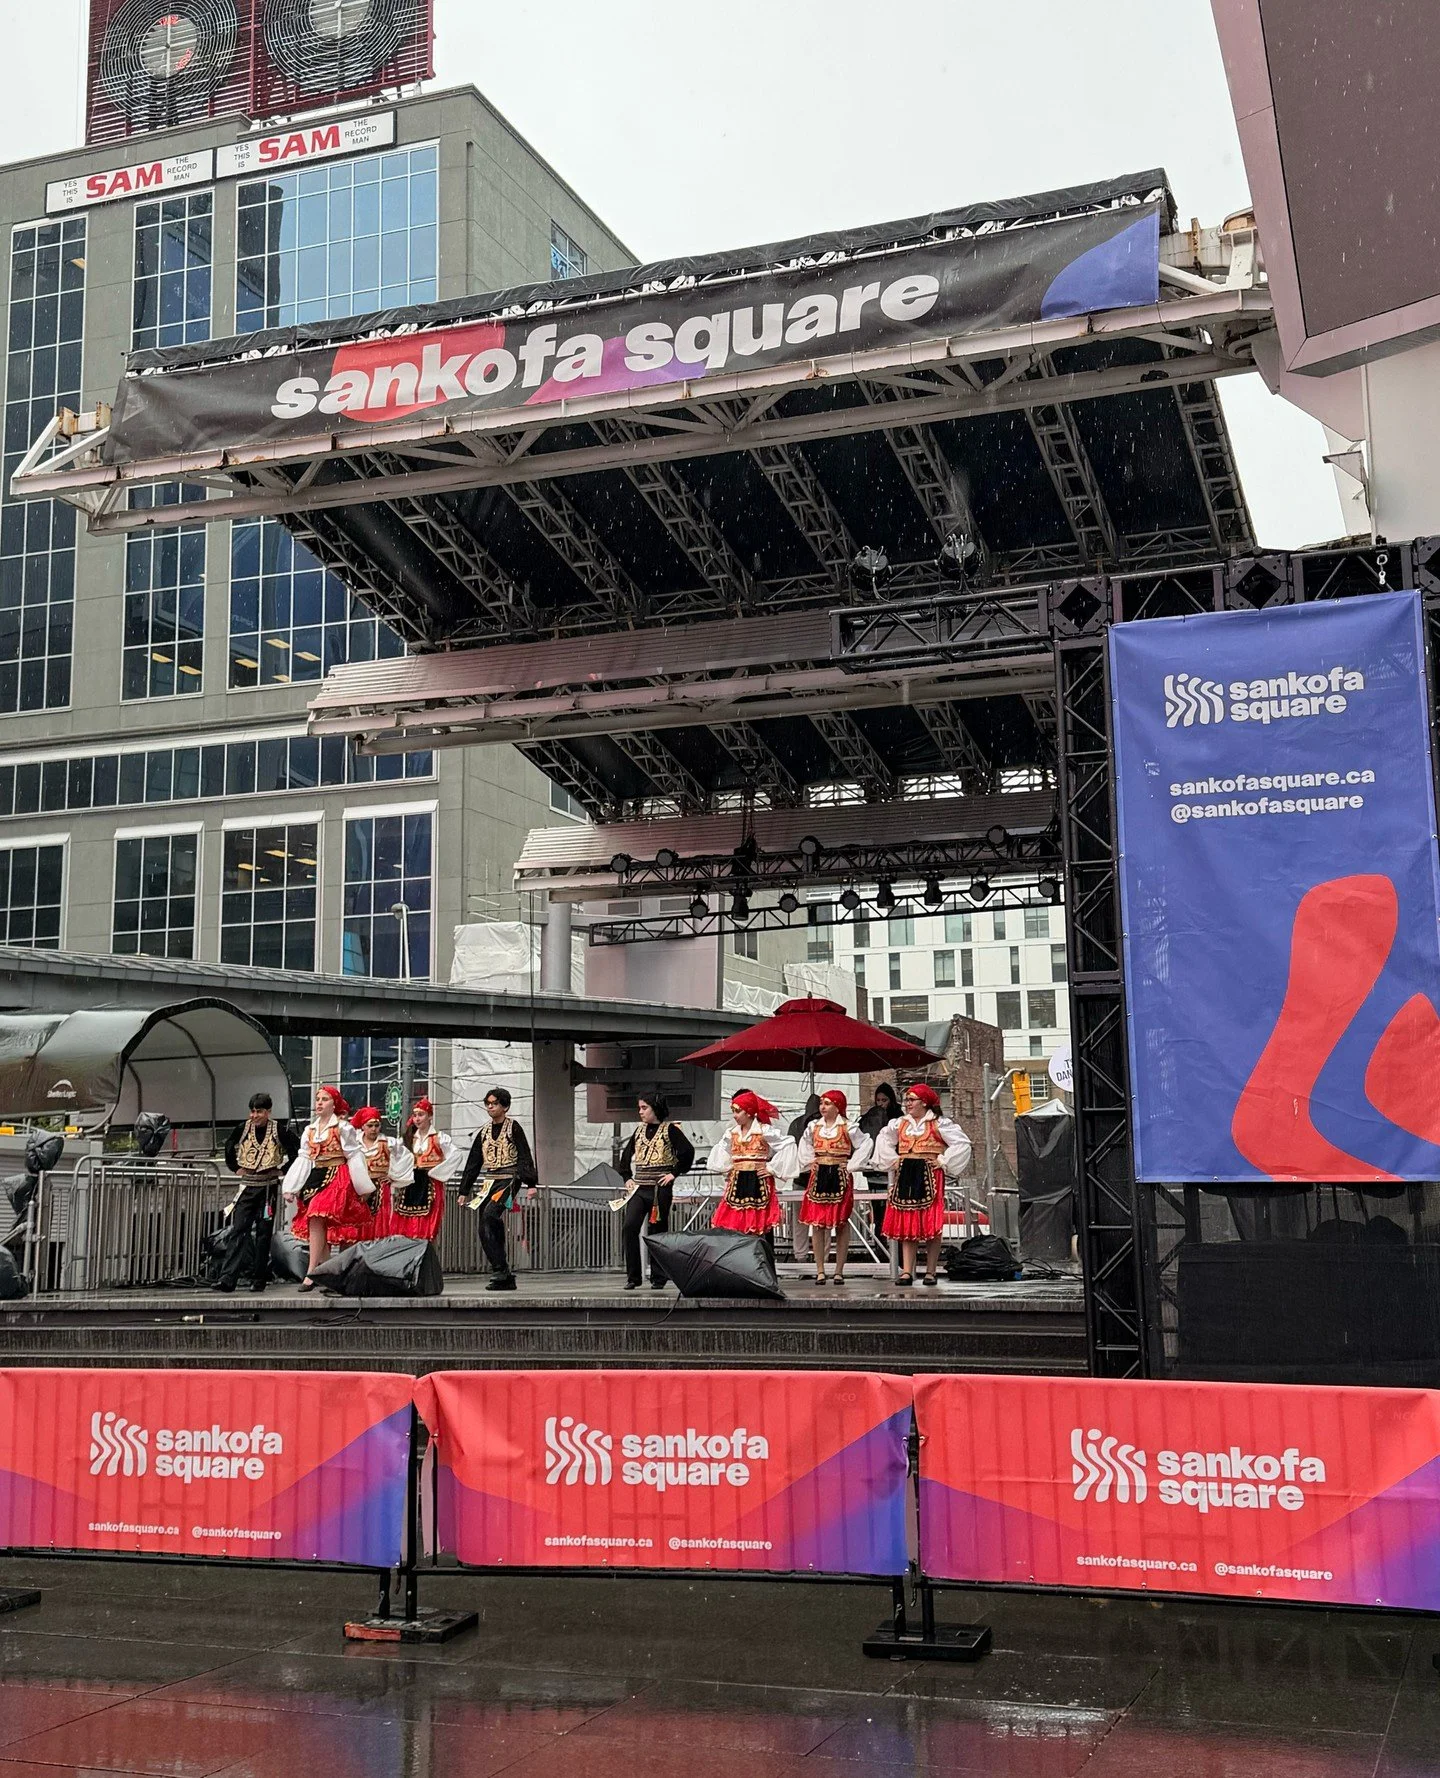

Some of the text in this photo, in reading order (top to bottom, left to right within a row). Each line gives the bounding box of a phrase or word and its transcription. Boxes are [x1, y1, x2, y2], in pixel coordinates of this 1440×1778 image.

[344, 125, 378, 138] RECORD
[353, 119, 369, 128] THE
[237, 143, 250, 153] YES
[258, 125, 341, 163] SAM
[352, 135, 370, 145] MAN
[174, 155, 190, 165] THE
[233, 151, 250, 161] THIS
[237, 161, 246, 169] IS
[86, 162, 163, 199] SAM
[166, 162, 198, 176] RECORD
[173, 172, 190, 182] MAN
[62, 188, 78, 197] THIS
[63, 179, 78, 188] YES
[66, 196, 74, 204] IS
[270, 272, 940, 422] sankofa square
[1228, 666, 1364, 701] sankofa
[1230, 694, 1347, 725] square
[1169, 769, 1375, 797] sankofasquare.ca
[1170, 794, 1364, 824] @sankofasquare
[155, 1424, 283, 1455] sankofa
[621, 1428, 770, 1460] sankofa
[155, 1452, 265, 1483] square
[621, 1459, 751, 1492] square
[1157, 1447, 1326, 1483] sankofa
[1158, 1478, 1304, 1513] square
[88, 1520, 282, 1542] sankofasquare.ca @sankofasquare
[544, 1534, 773, 1552] sankofasquare.ca @sankofasquare
[1076, 1554, 1333, 1582] sankofasquare.ca @sankofasquare
